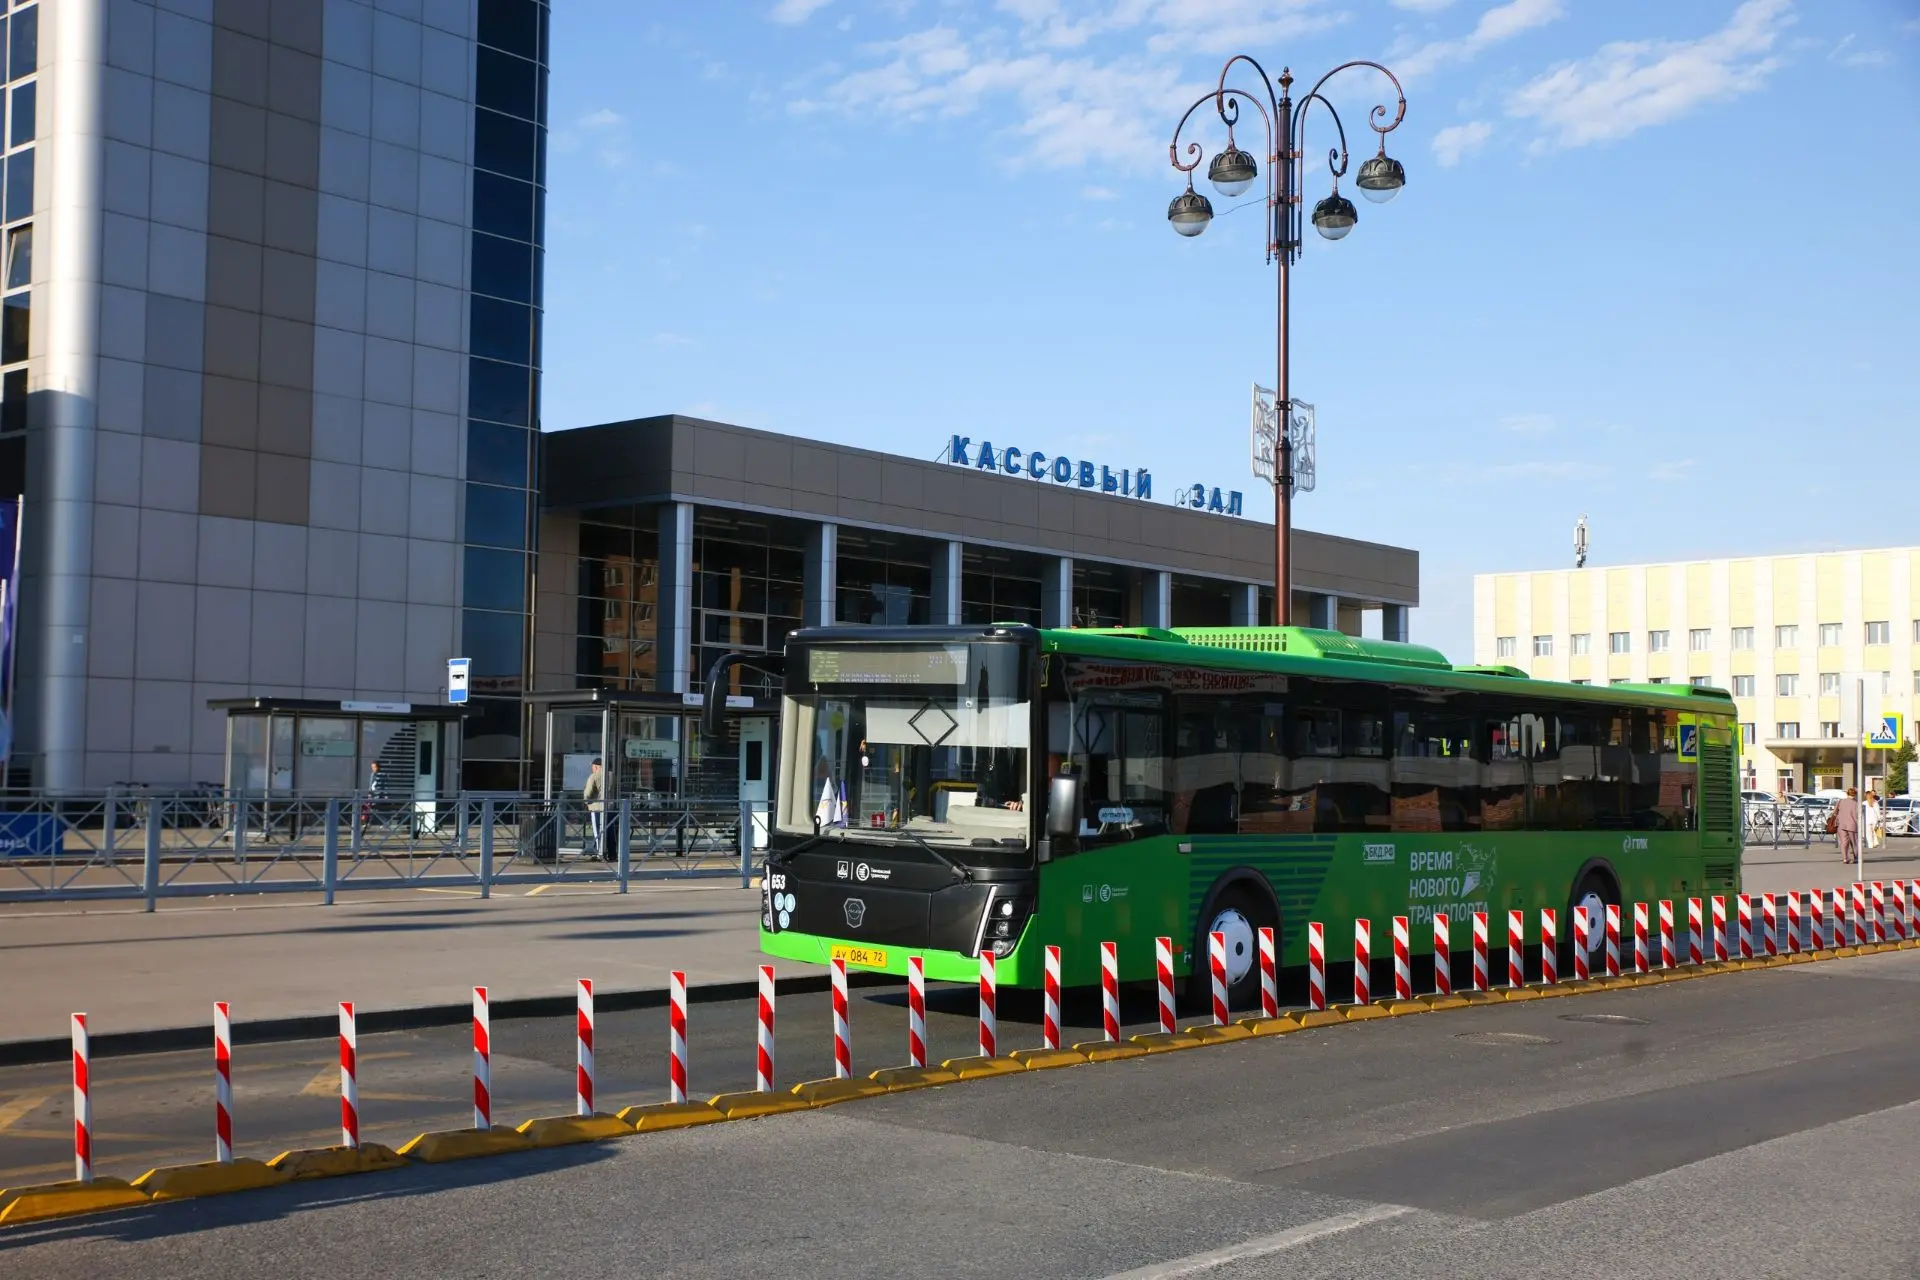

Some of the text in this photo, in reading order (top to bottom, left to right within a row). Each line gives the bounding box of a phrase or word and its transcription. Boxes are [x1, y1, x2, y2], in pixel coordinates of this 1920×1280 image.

[951, 434, 1243, 516] КАССОВЫЙ ЗАЛ
[1409, 851, 1453, 872] ВРЕМЯ
[771, 874, 786, 890] 653
[1408, 877, 1460, 898] НОВОГО
[850, 949, 868, 963] 084
[873, 951, 883, 962] 72
